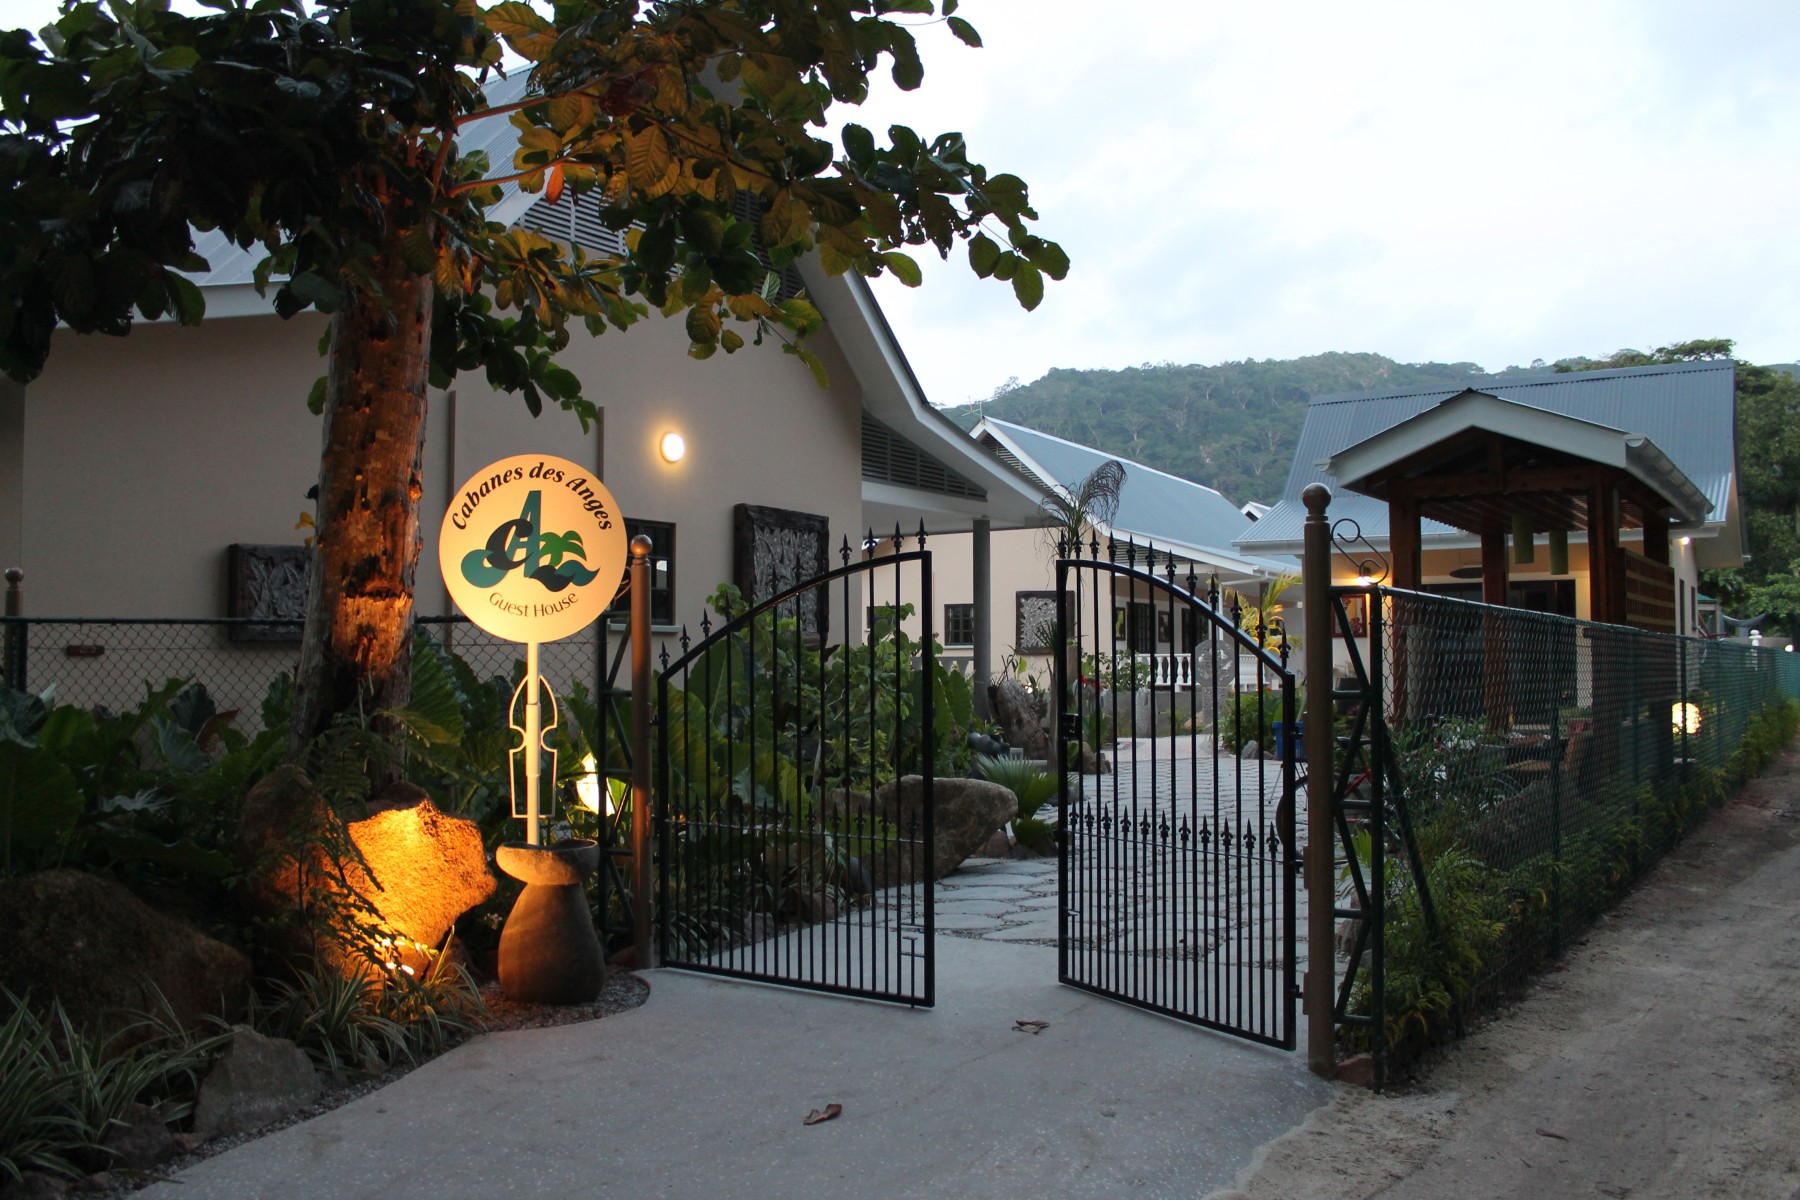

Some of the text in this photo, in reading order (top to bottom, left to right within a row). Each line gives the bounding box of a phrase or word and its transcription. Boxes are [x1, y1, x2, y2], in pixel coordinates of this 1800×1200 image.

[452, 462, 612, 530] Cabanes des Anges
[489, 592, 579, 617] Guest House
